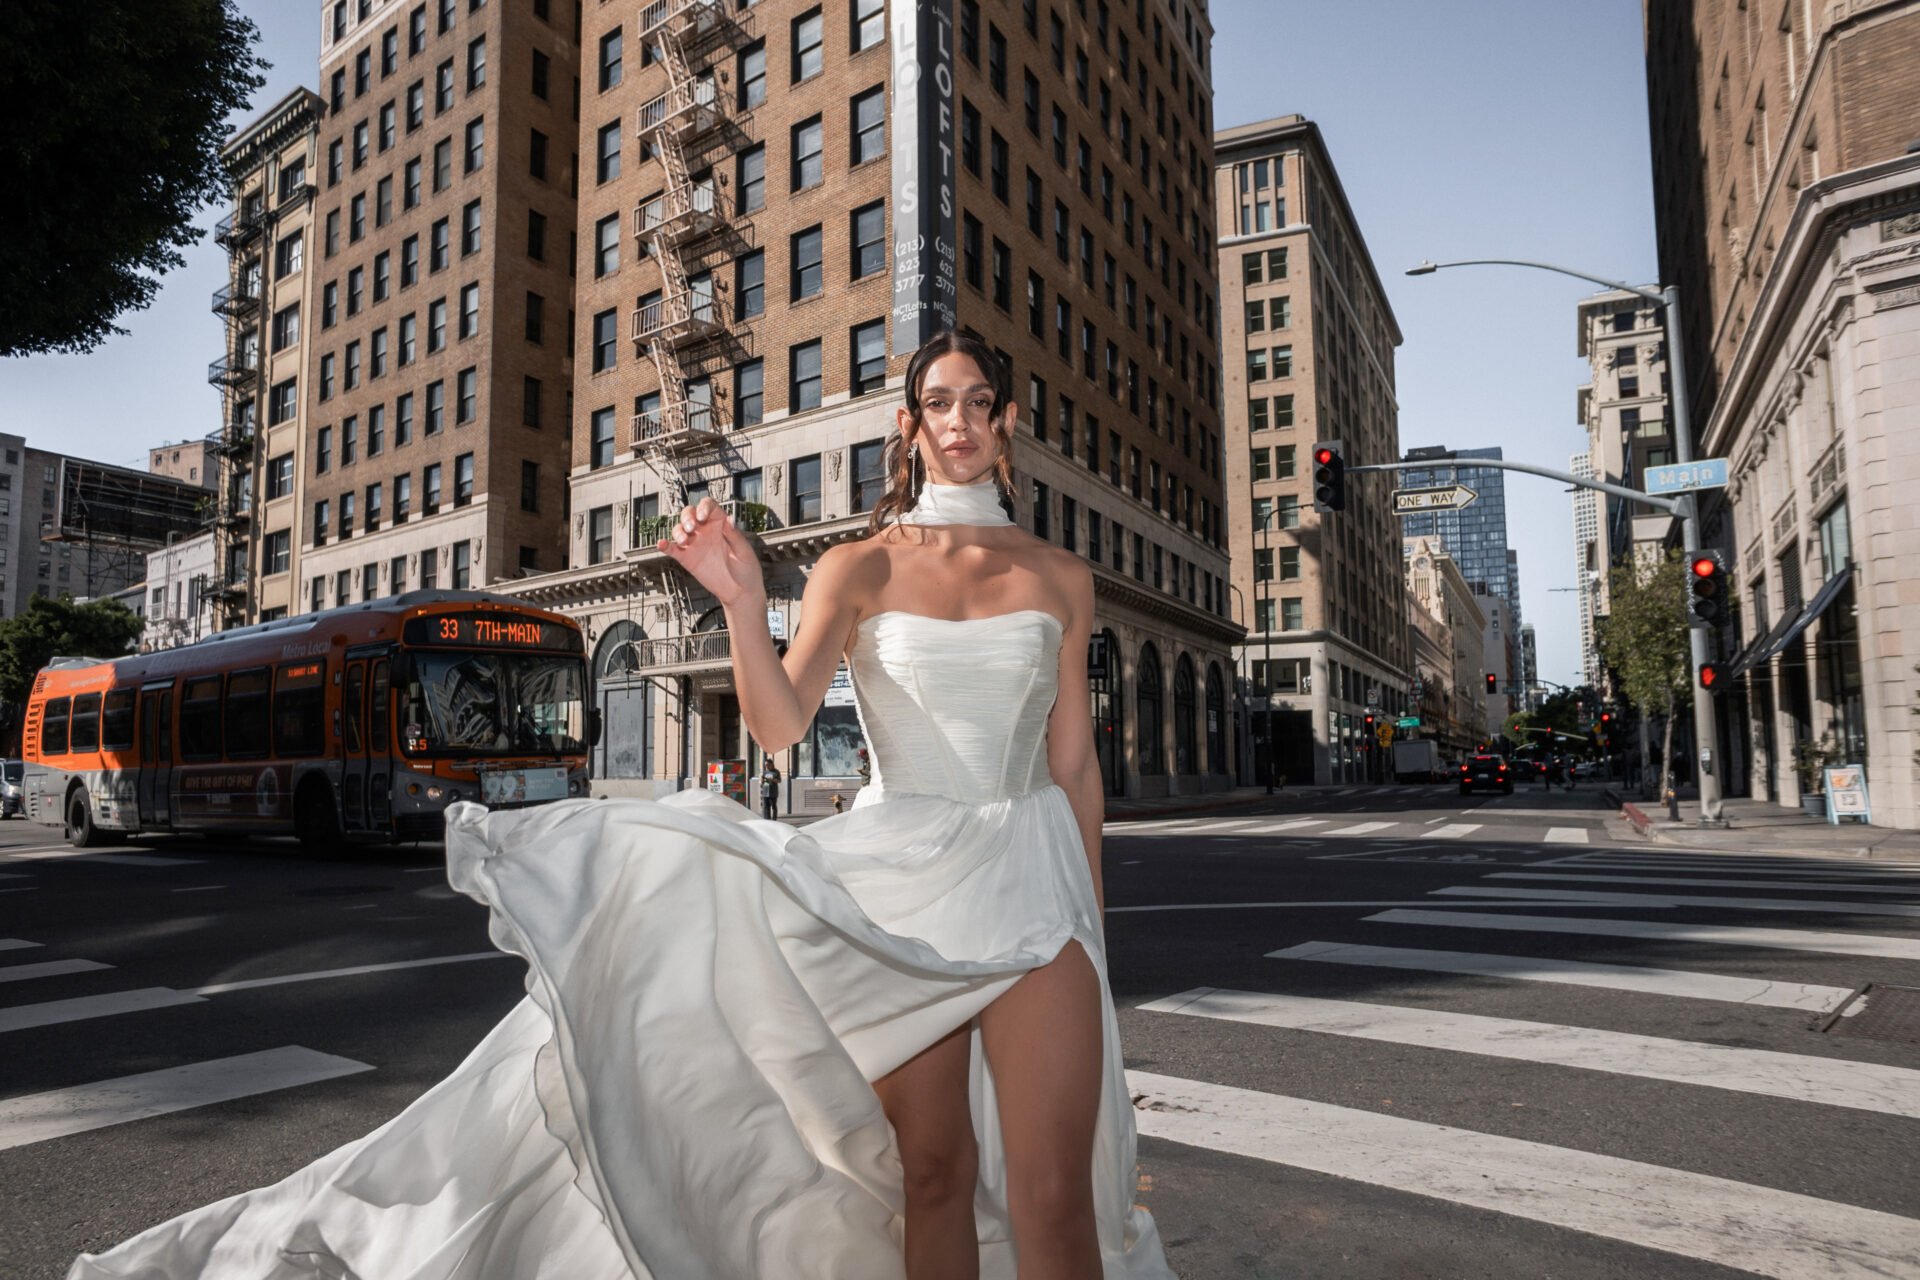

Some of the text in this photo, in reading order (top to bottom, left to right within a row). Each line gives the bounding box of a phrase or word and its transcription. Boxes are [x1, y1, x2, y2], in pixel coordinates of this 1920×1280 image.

[898, 22, 922, 213] LOFTS
[935, 21, 952, 218] LOFTS
[895, 234, 925, 257] (213)
[935, 236, 955, 262] (213)
[899, 256, 920, 273] 623
[940, 260, 953, 278] 623
[895, 274, 925, 292] 3777
[935, 275, 955, 296] 3777
[1658, 467, 1713, 485] Main
[1399, 492, 1455, 507] ONE WAY
[440, 618, 541, 643] 33 7TH-MAIN
[307, 640, 331, 655] Local
[485, 775, 517, 802] 99
